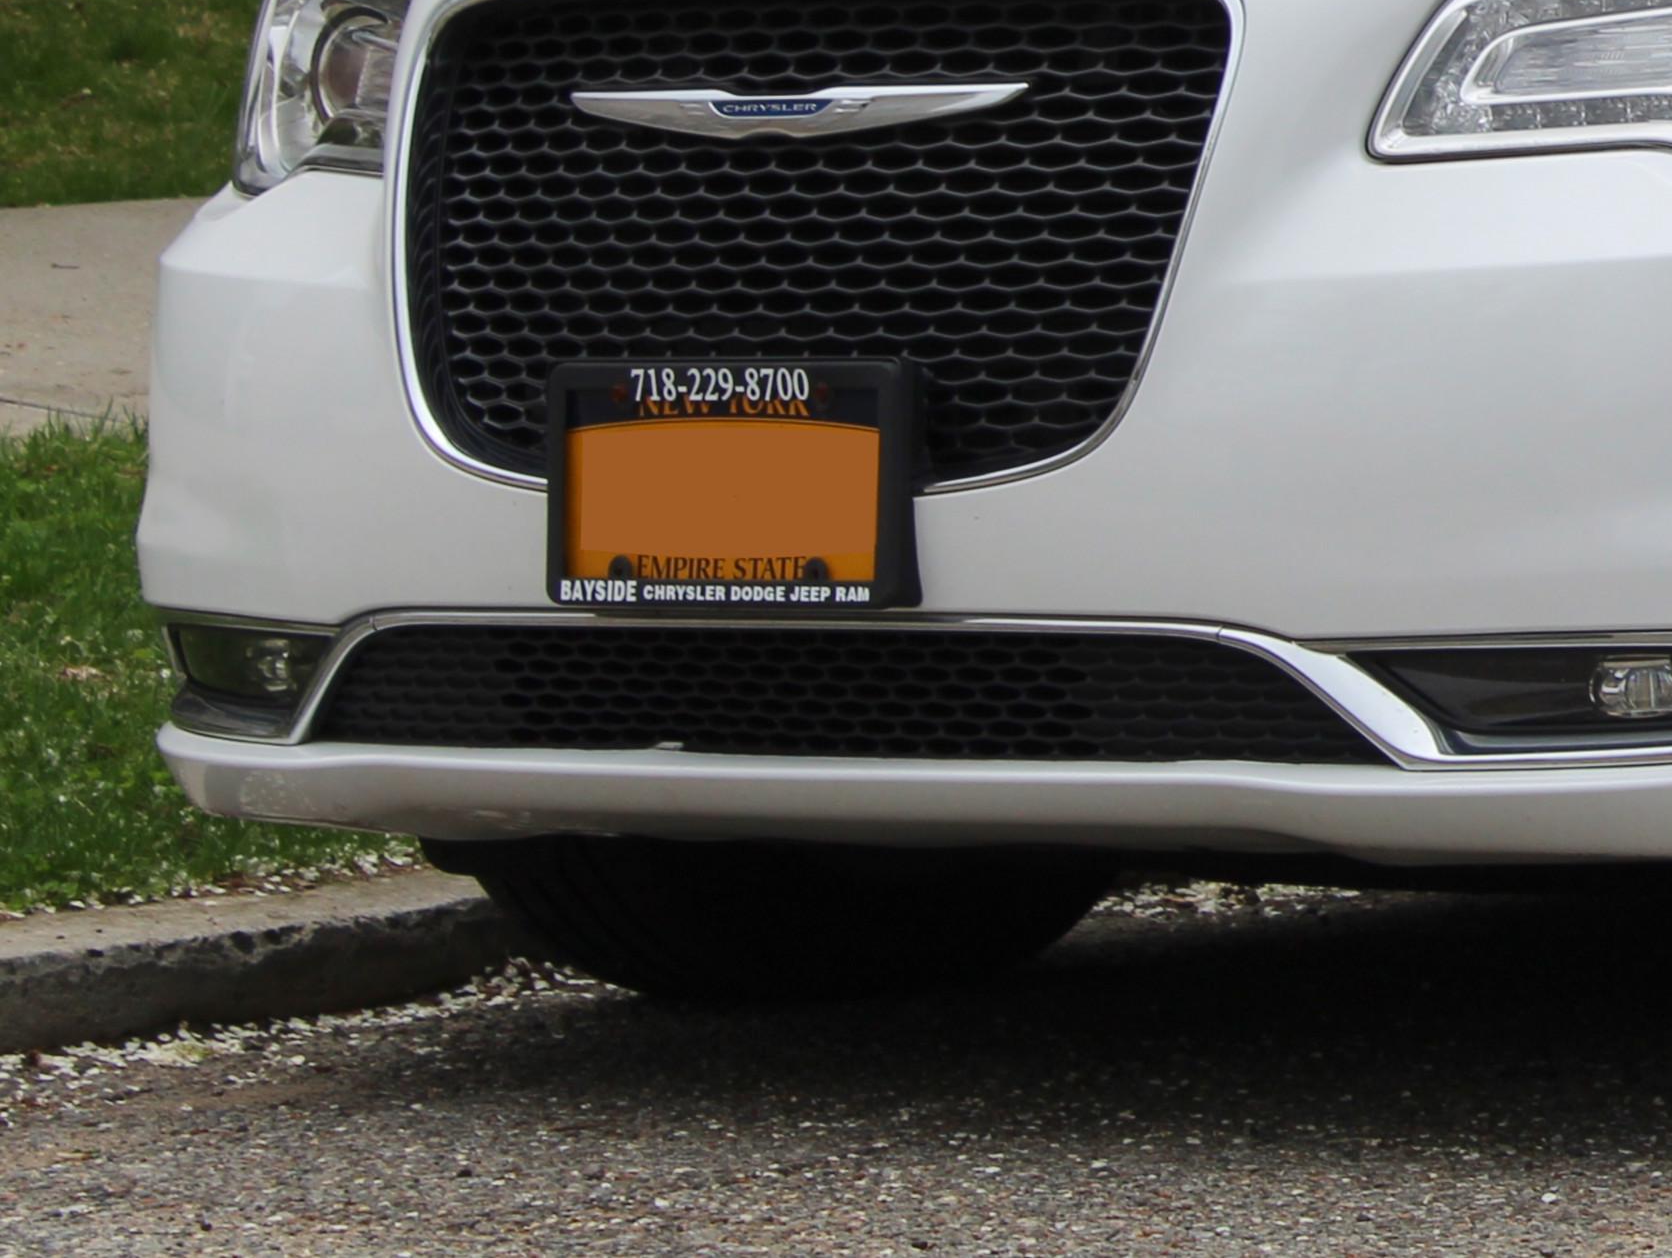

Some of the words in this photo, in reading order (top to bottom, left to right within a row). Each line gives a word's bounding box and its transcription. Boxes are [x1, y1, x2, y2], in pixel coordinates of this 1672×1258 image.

[723, 103, 817, 113] CHRYSLER
[630, 367, 810, 402] 718-229-8700
[636, 554, 726, 580] EMPIRE
[560, 580, 637, 602] BAYSIDE
[643, 585, 726, 602] CHRYSLER
[730, 586, 786, 602] DODGE
[790, 586, 831, 602] JEEP
[835, 586, 870, 602] RAM
